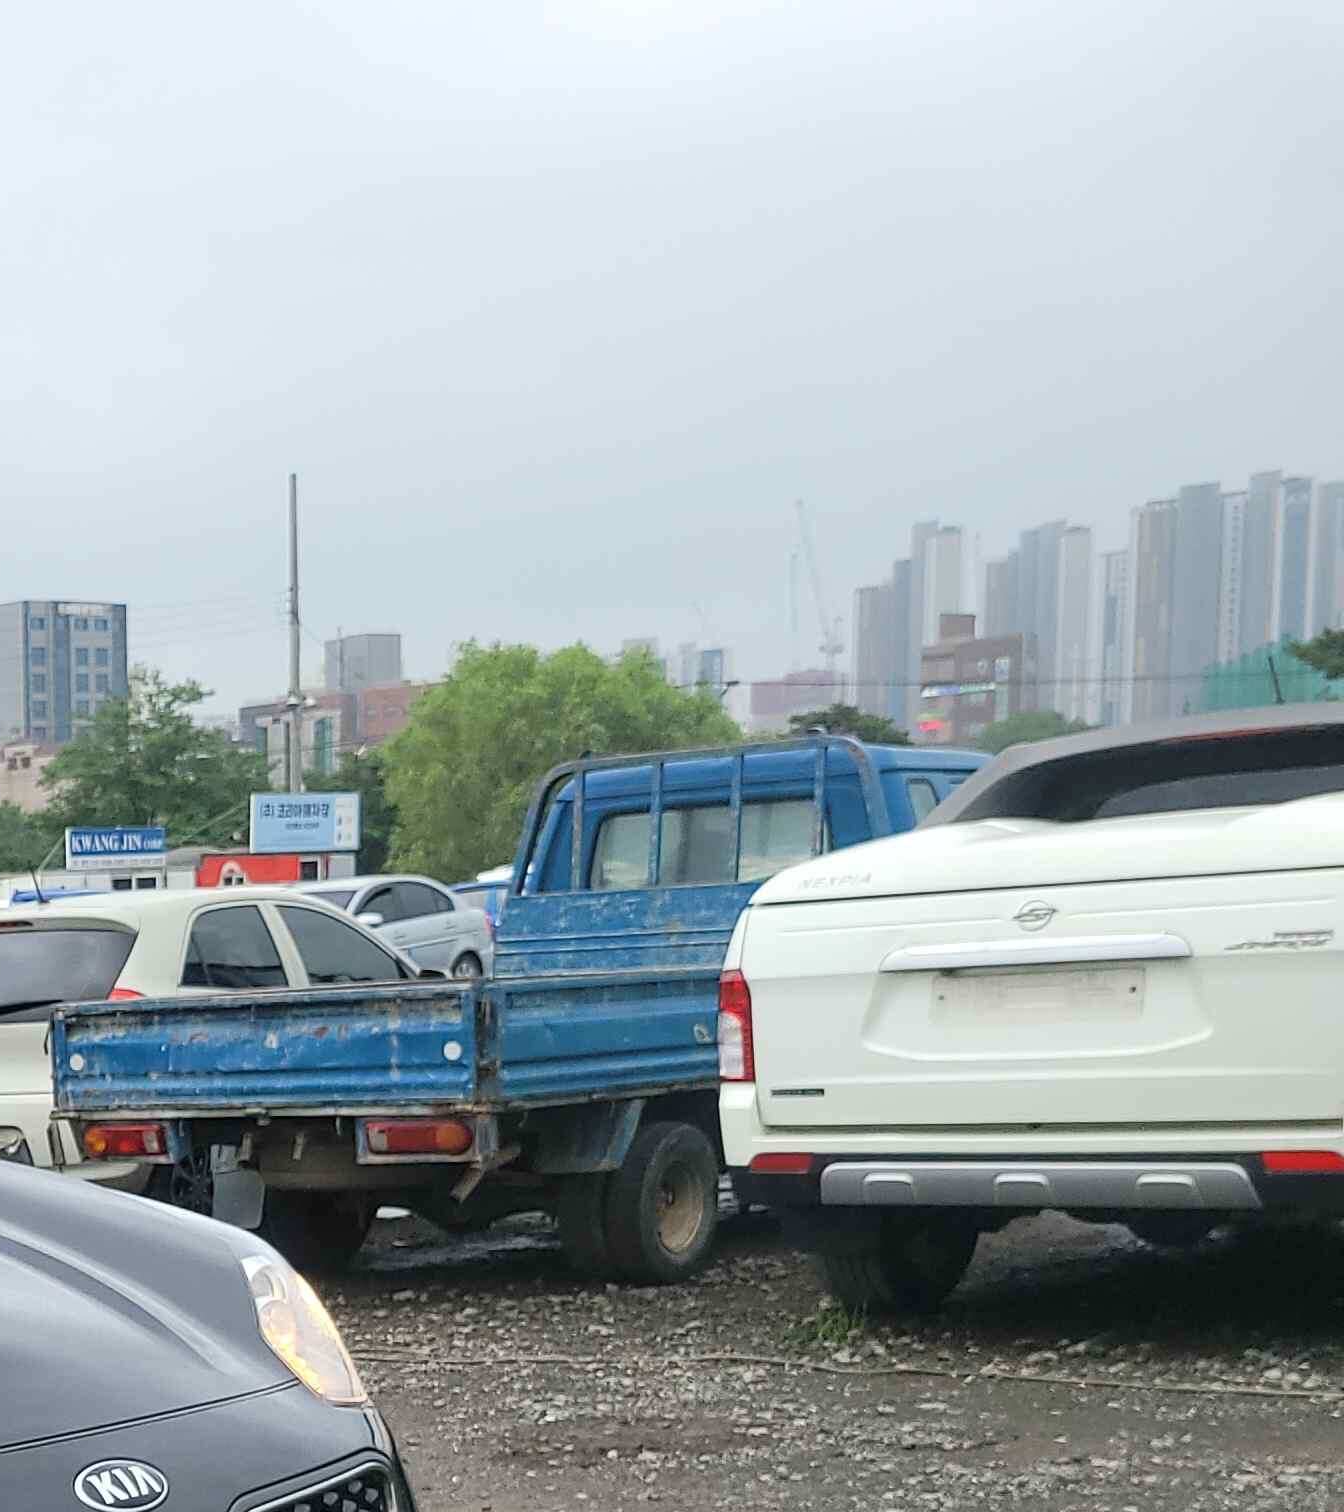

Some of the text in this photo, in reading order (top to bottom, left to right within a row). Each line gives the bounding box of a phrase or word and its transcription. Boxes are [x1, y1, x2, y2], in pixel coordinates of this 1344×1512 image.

[71, 831, 120, 853] KWANG
[121, 832, 143, 851] JIN
[86, 1465, 162, 1505] KIA
